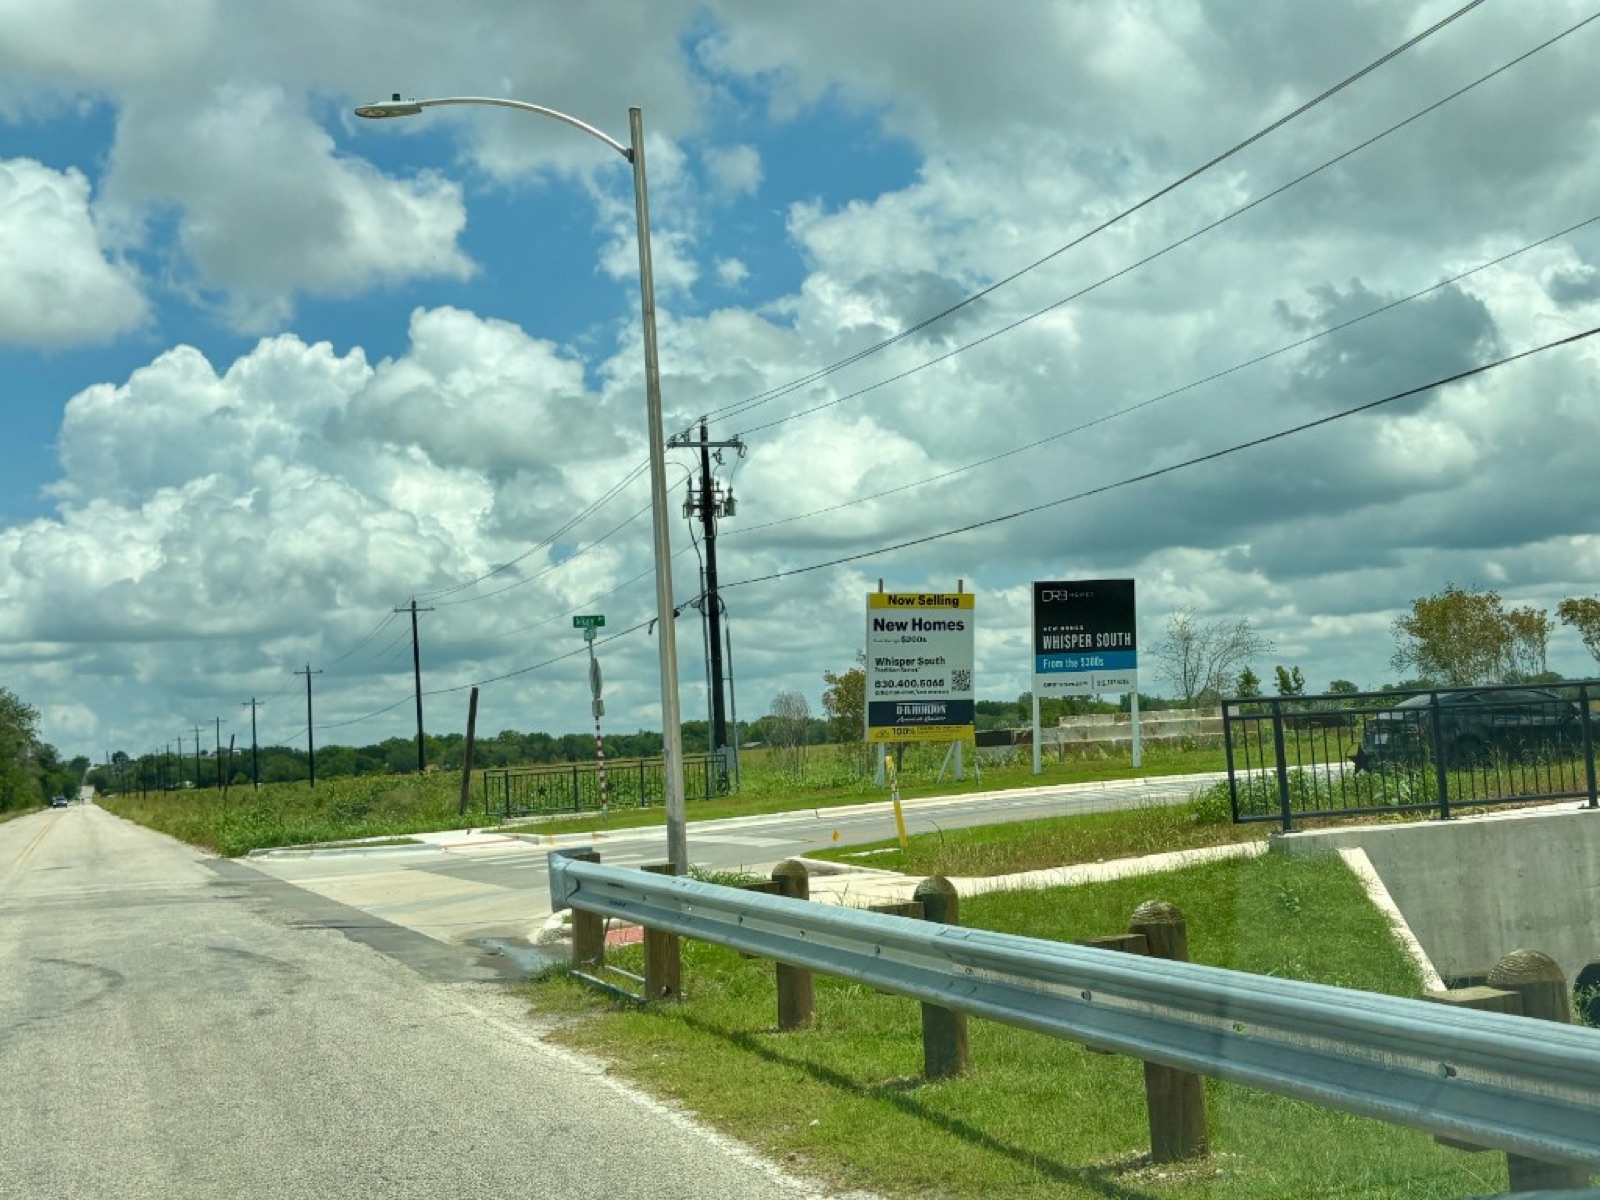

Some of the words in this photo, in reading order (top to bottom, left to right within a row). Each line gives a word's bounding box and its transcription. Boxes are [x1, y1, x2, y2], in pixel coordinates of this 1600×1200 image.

[888, 594, 915, 606] Now
[918, 594, 960, 609] Selling
[873, 618, 908, 632] New
[912, 616, 965, 631] Homes
[1042, 633, 1093, 650] WHISPER
[1096, 632, 1132, 648] SOUTH
[874, 655, 916, 667] Whisper
[917, 655, 946, 665] South
[1043, 658, 1064, 669] From
[1065, 657, 1079, 668] the
